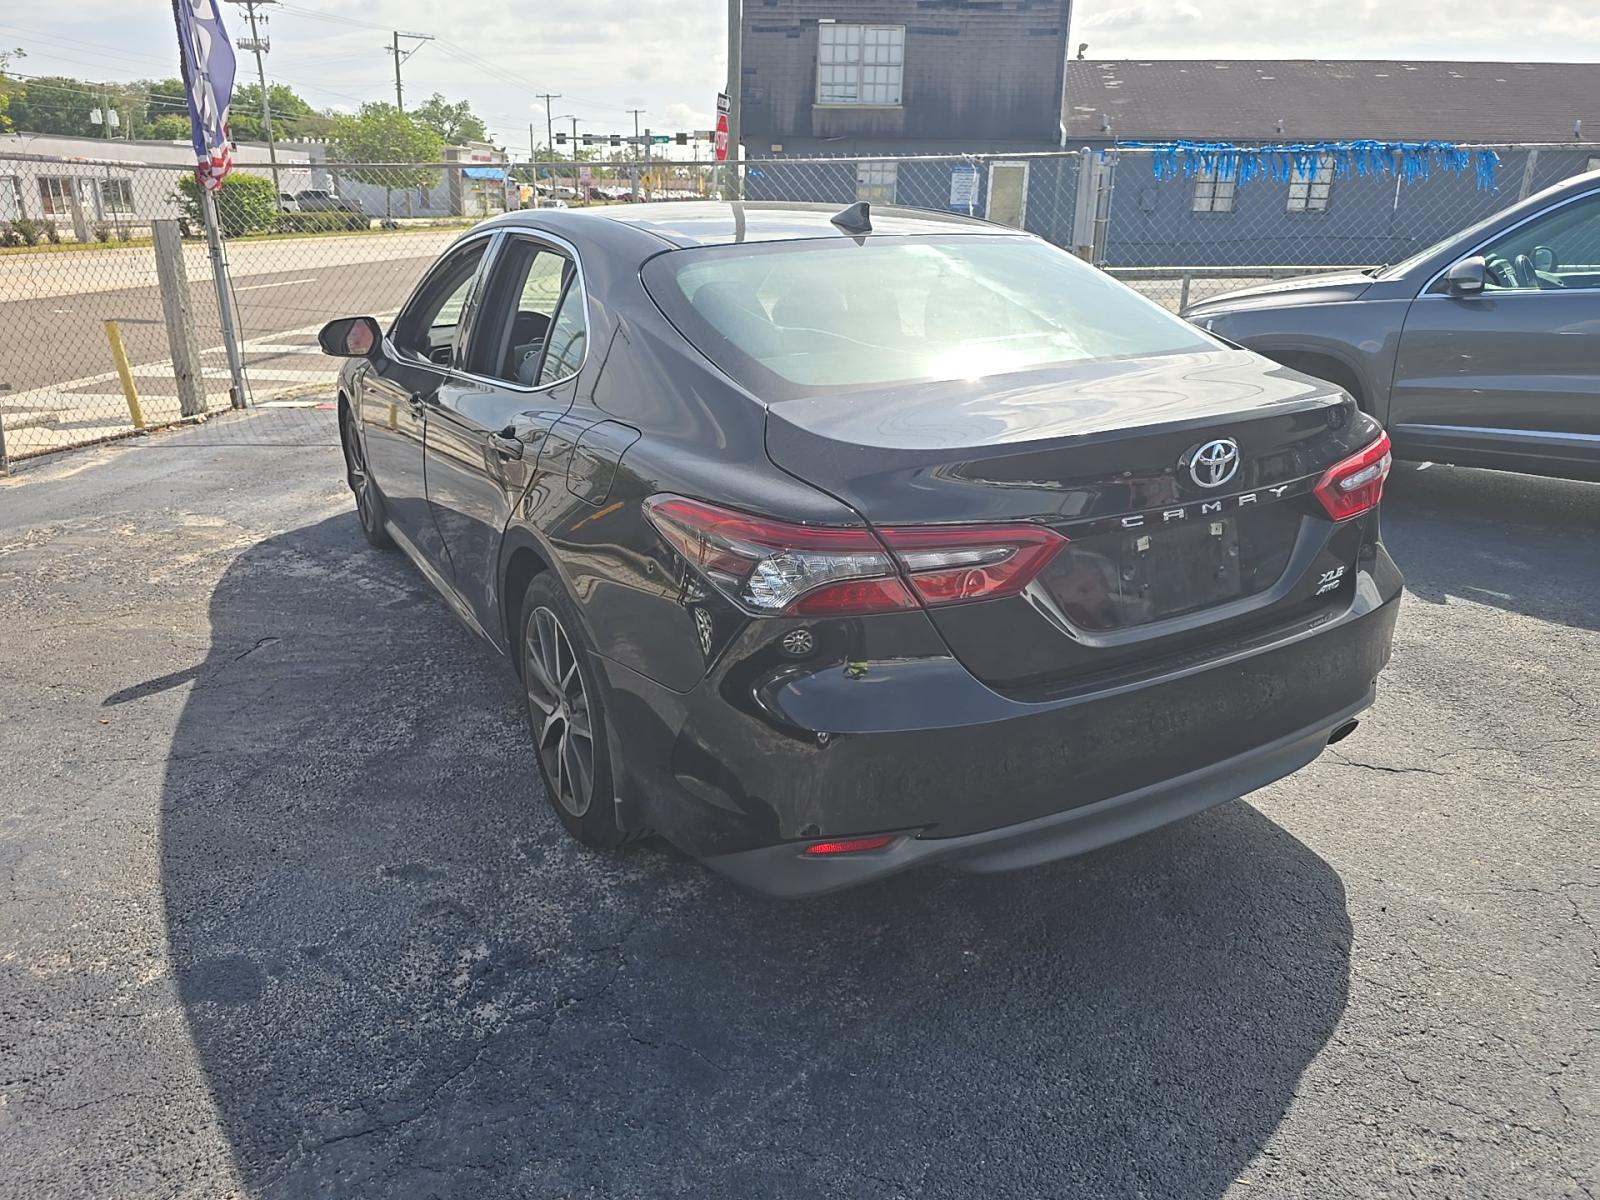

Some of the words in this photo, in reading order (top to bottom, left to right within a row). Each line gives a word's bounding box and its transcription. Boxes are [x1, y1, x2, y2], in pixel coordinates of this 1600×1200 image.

[715, 131, 728, 150] STOP
[1121, 485, 1289, 528] CAMRY
[1317, 565, 1345, 584] XLE
